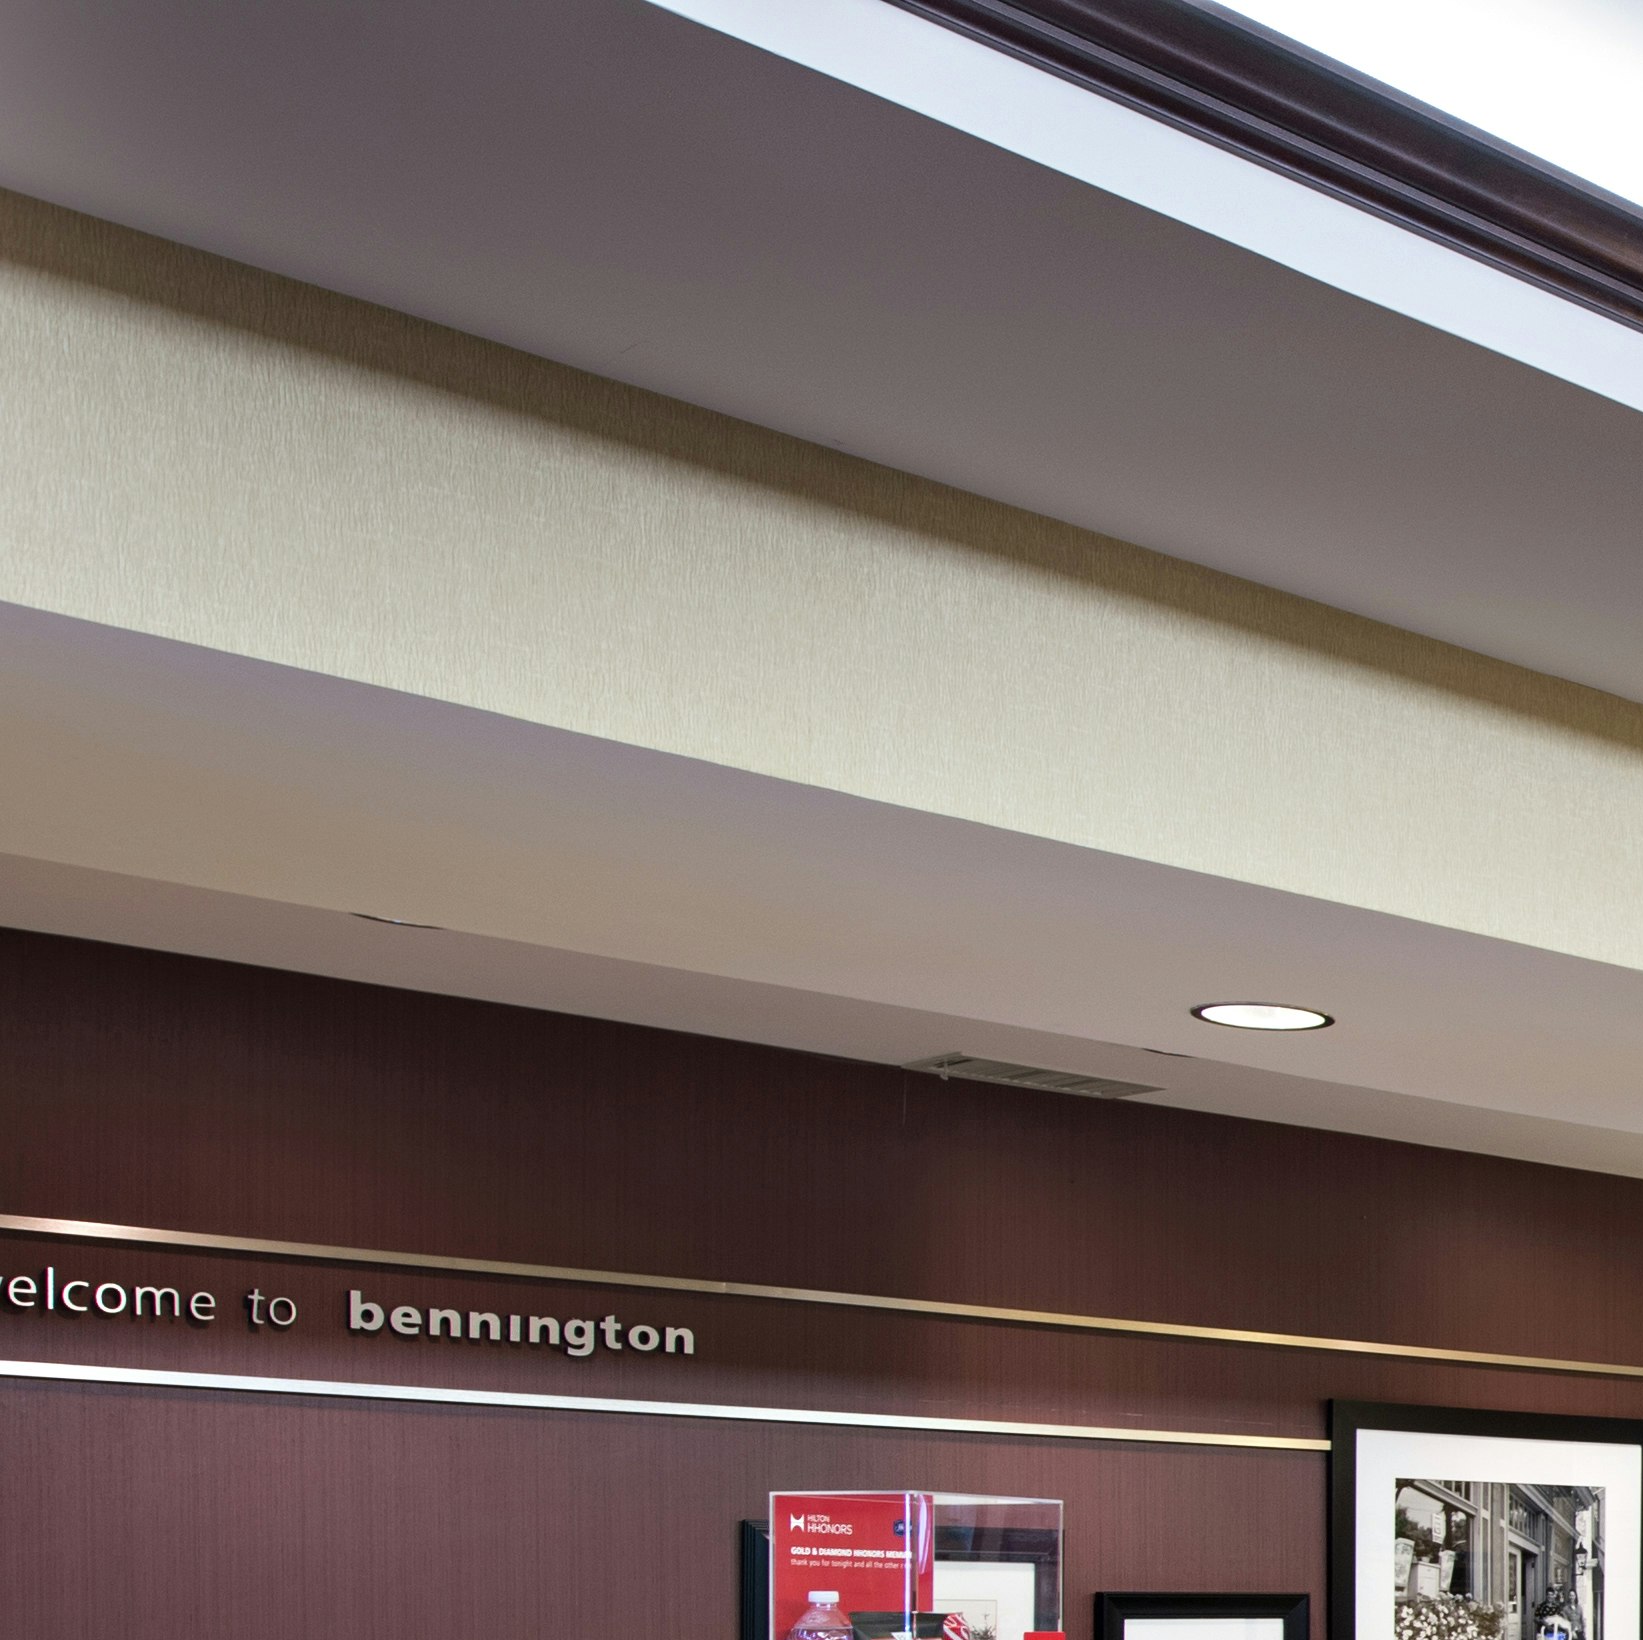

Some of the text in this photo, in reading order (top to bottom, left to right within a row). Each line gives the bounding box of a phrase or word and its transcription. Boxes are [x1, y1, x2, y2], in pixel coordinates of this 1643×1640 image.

[0, 1266, 696, 1356] elcome to bennington
[807, 1514, 830, 1523] HILTON
[807, 1523, 853, 1536] HHONORS
[790, 1547, 811, 1556] GOLD
